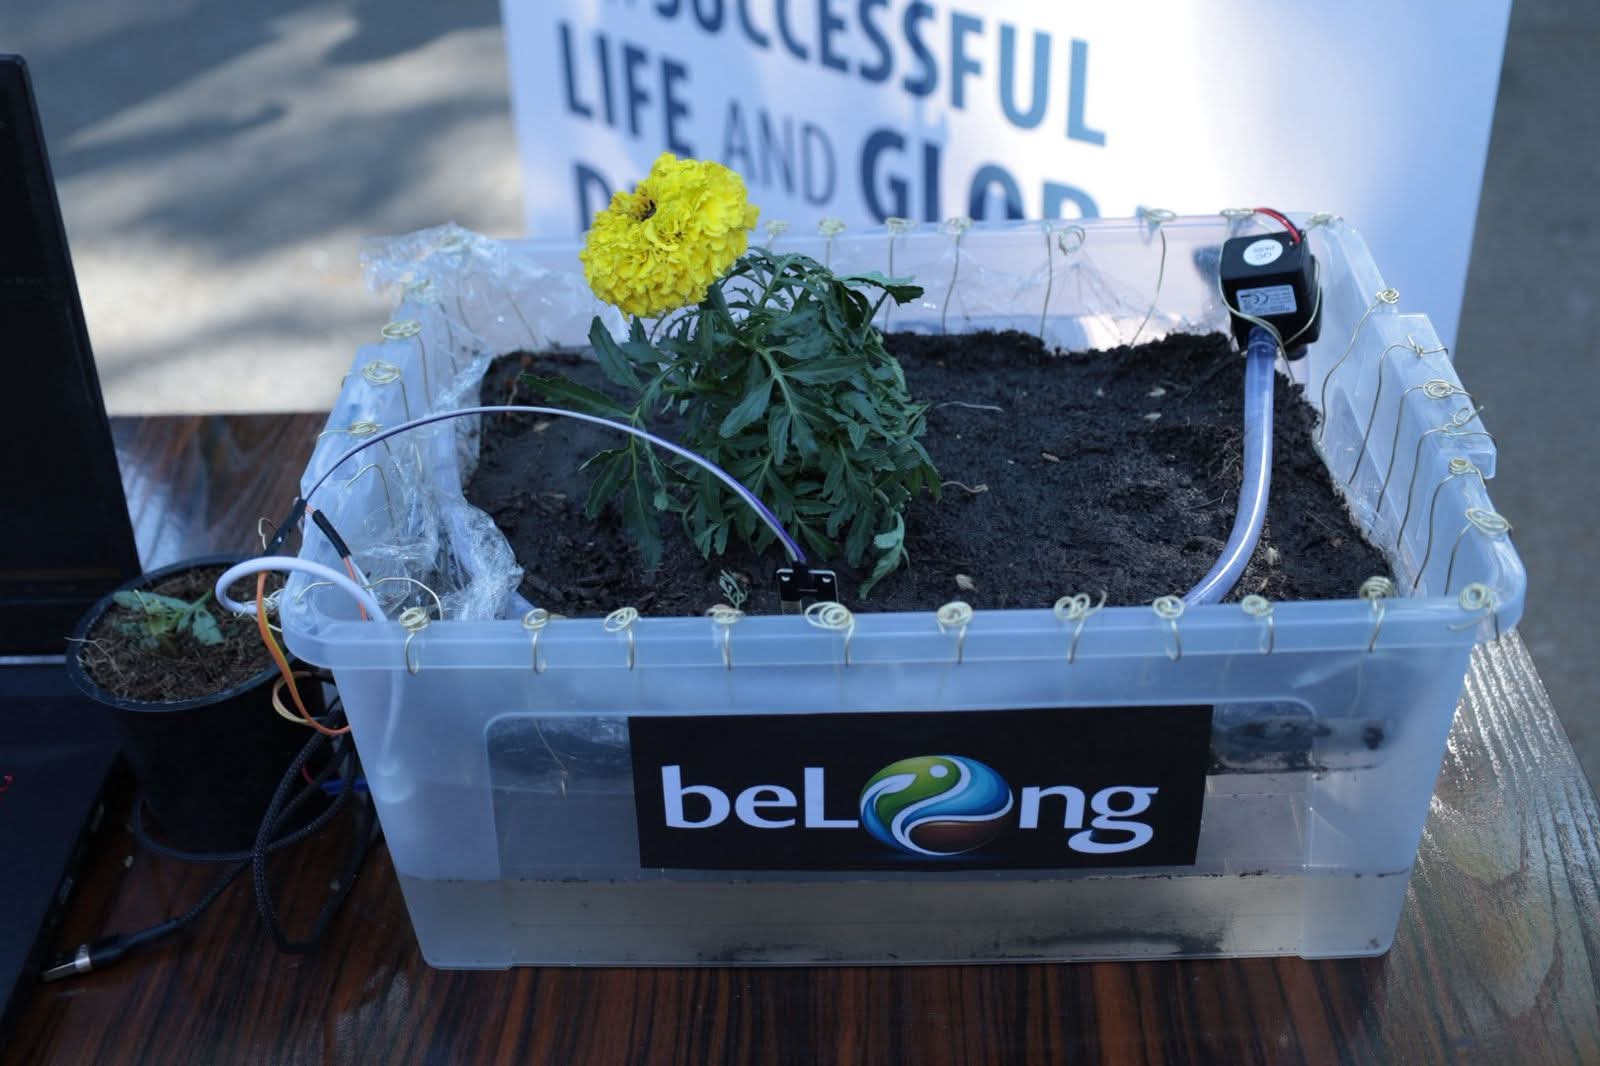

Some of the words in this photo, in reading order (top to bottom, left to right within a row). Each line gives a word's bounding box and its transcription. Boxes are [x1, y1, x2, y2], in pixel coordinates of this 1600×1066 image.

[559, 20, 693, 157] LIFE
[723, 98, 837, 206] AND
[656, 0, 1106, 147] CCESSFUL
